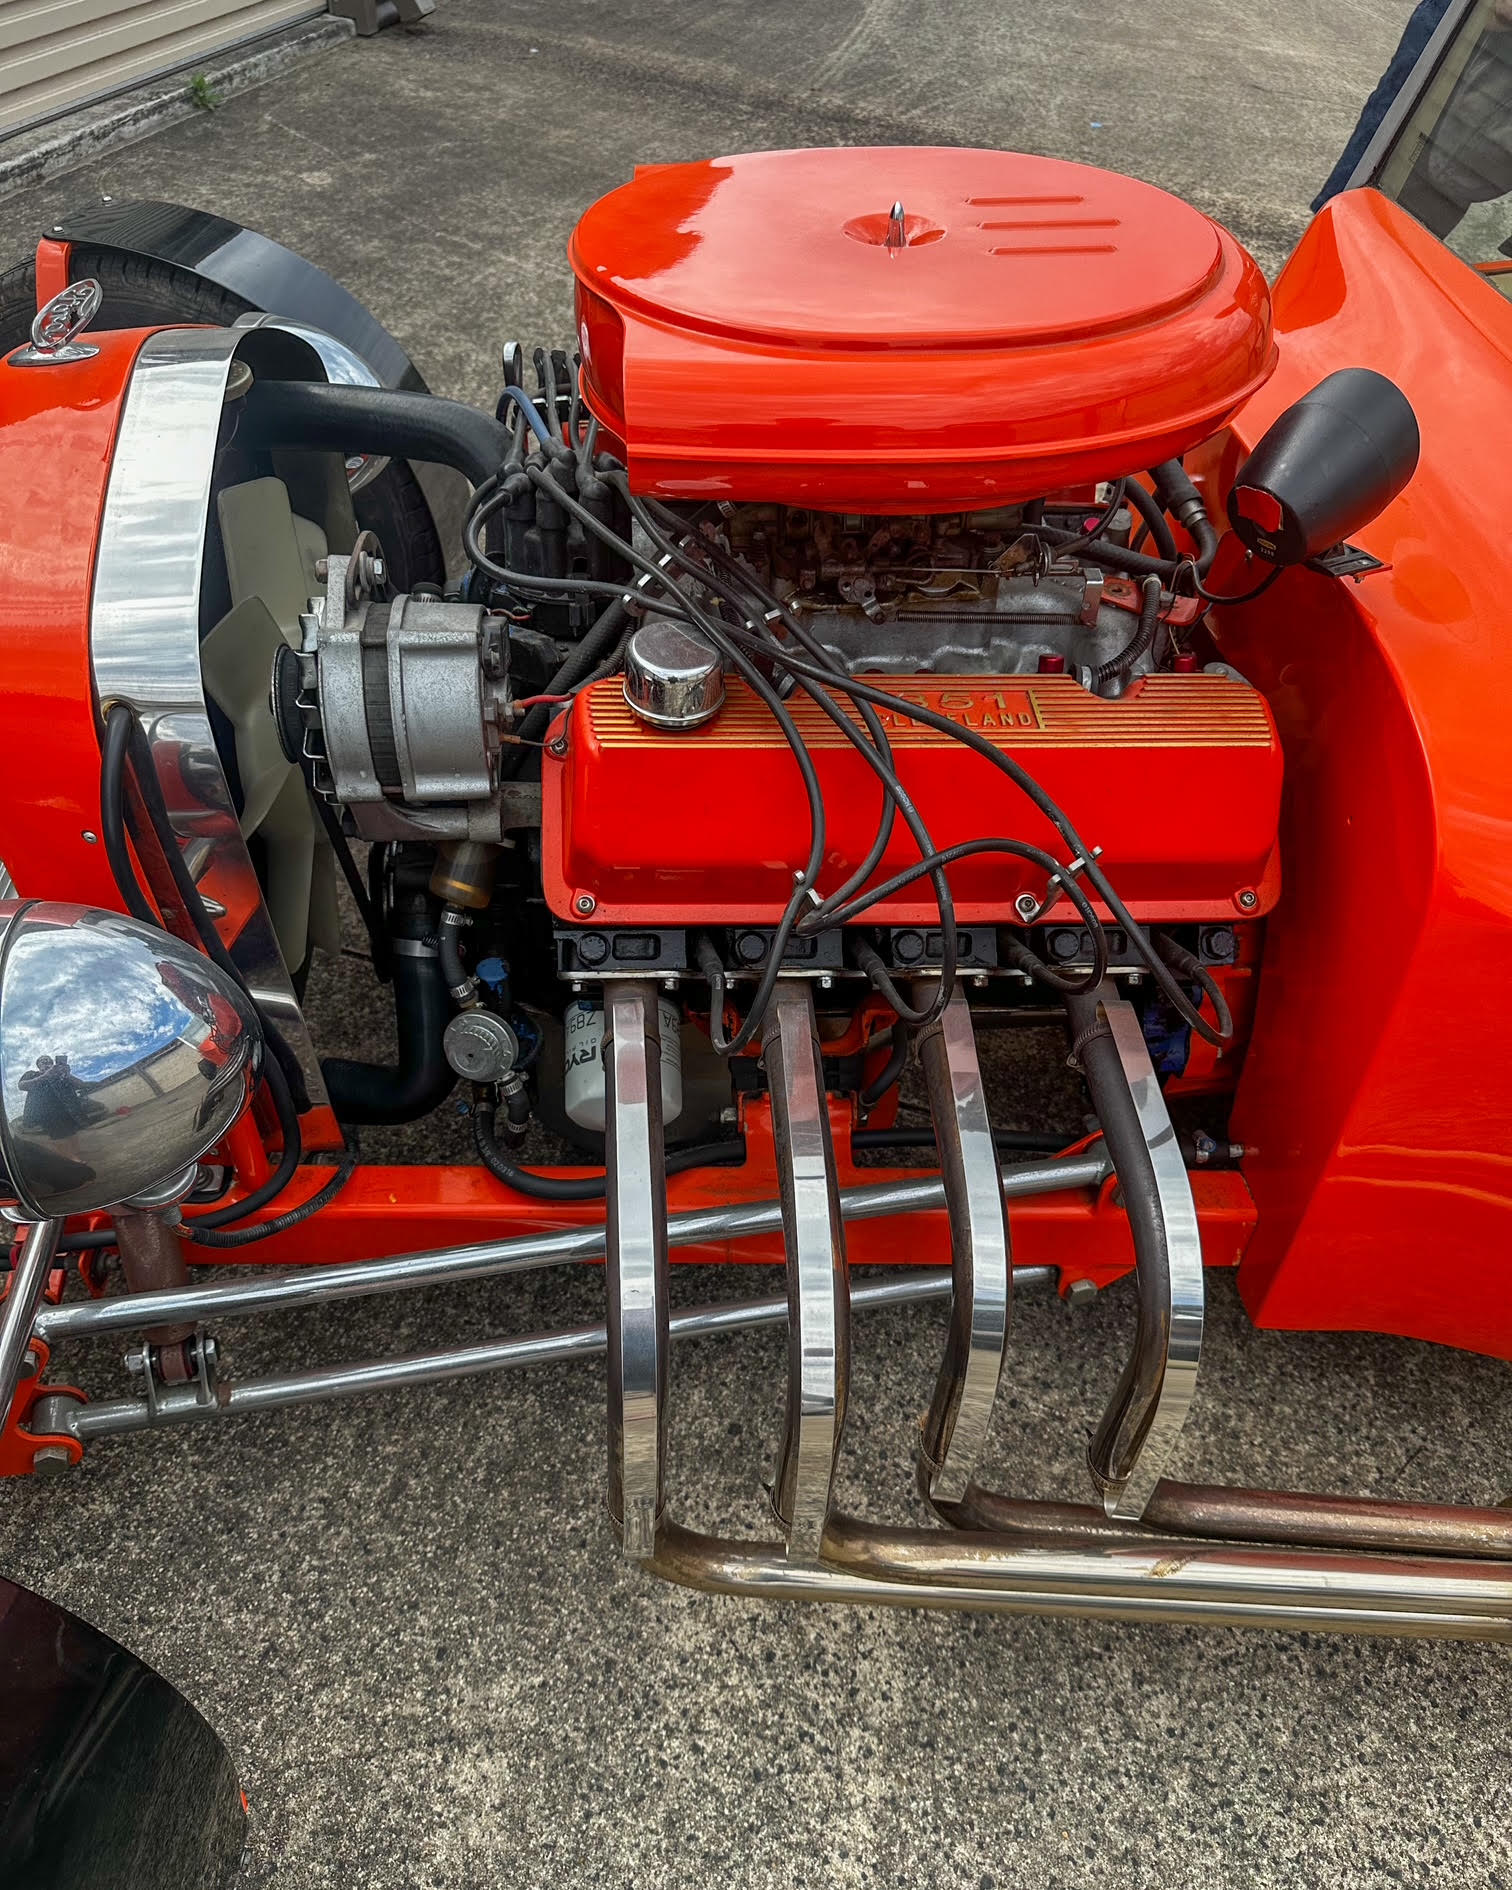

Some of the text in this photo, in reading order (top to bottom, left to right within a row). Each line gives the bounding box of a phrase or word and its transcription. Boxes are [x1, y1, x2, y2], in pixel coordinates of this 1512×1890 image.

[44, 285, 96, 338] Ford
[899, 691, 1007, 710] 351
[878, 711, 1032, 727] CLELAND
[566, 1009, 597, 1037] Z89
[563, 1045, 597, 1076] RYC
